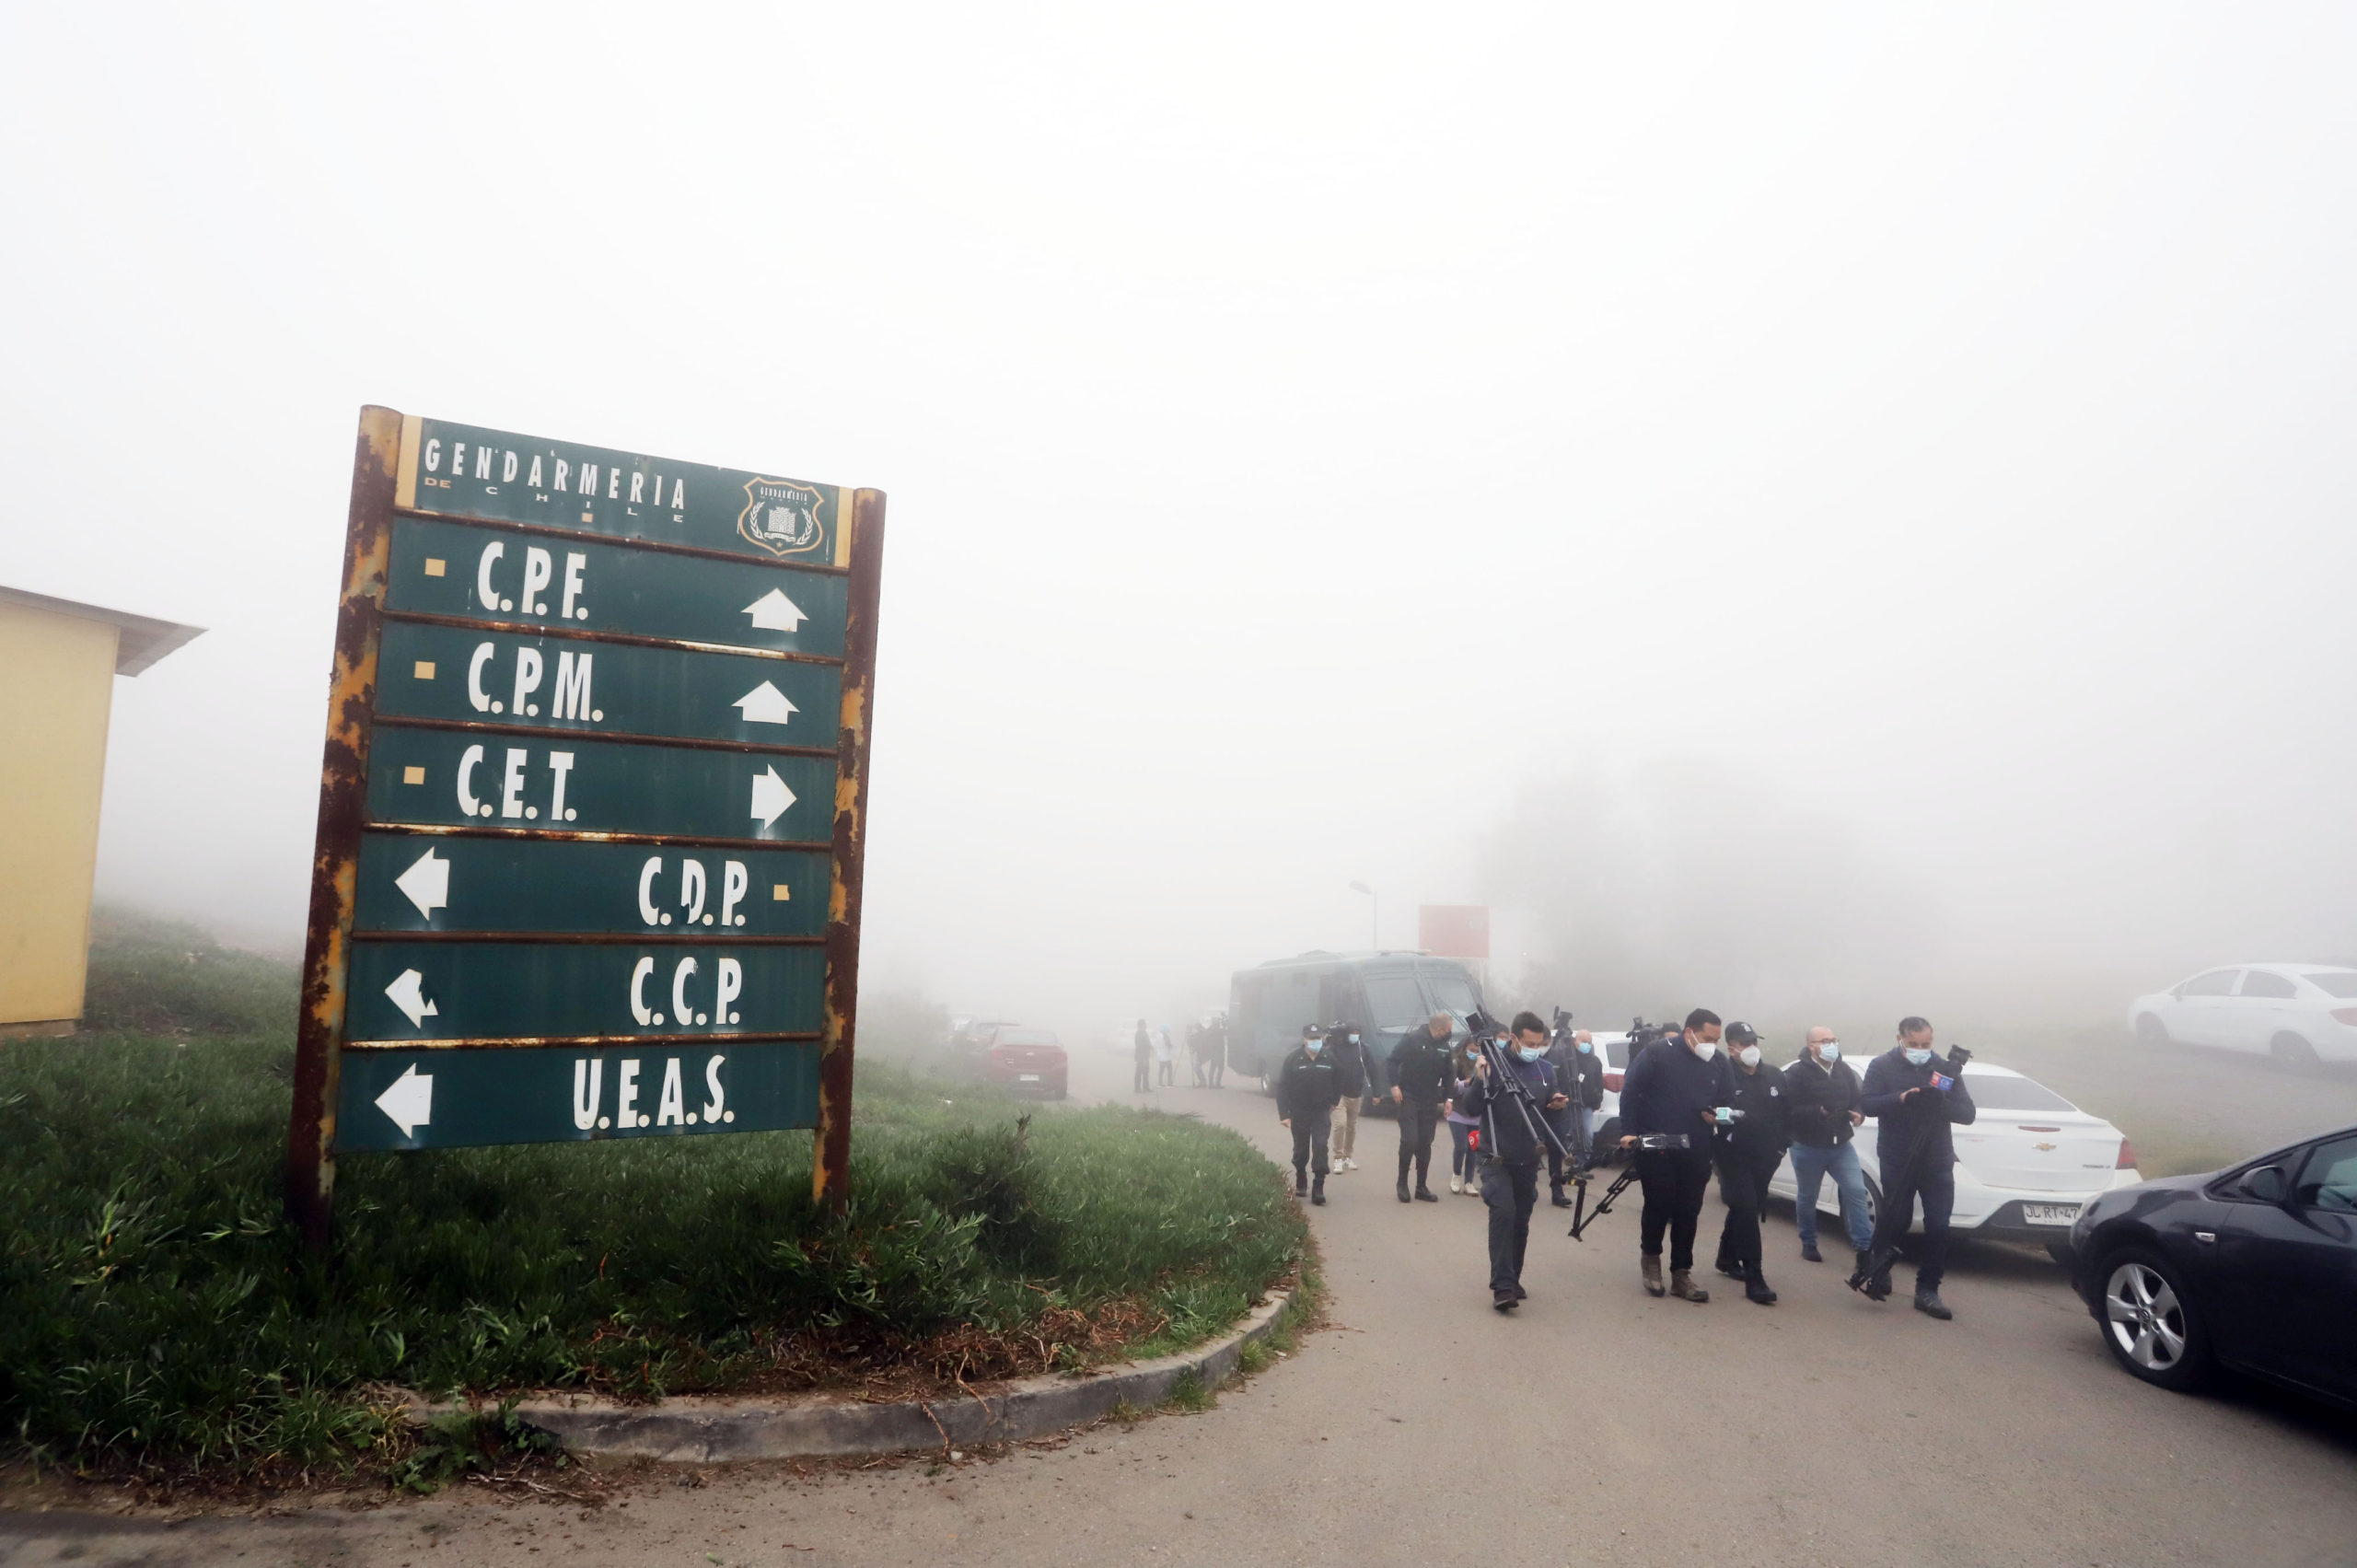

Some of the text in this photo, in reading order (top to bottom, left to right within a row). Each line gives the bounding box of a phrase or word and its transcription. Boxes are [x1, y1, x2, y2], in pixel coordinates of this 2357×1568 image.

[424, 438, 685, 511] GENDARMERIA
[424, 477, 451, 489] DE
[477, 540, 589, 621] C.P.F.
[457, 744, 577, 821] C.E.T.
[638, 856, 749, 927] C.D.P.
[630, 957, 742, 1026] C.C.P.
[573, 1054, 735, 1131] U.E.A.S.
